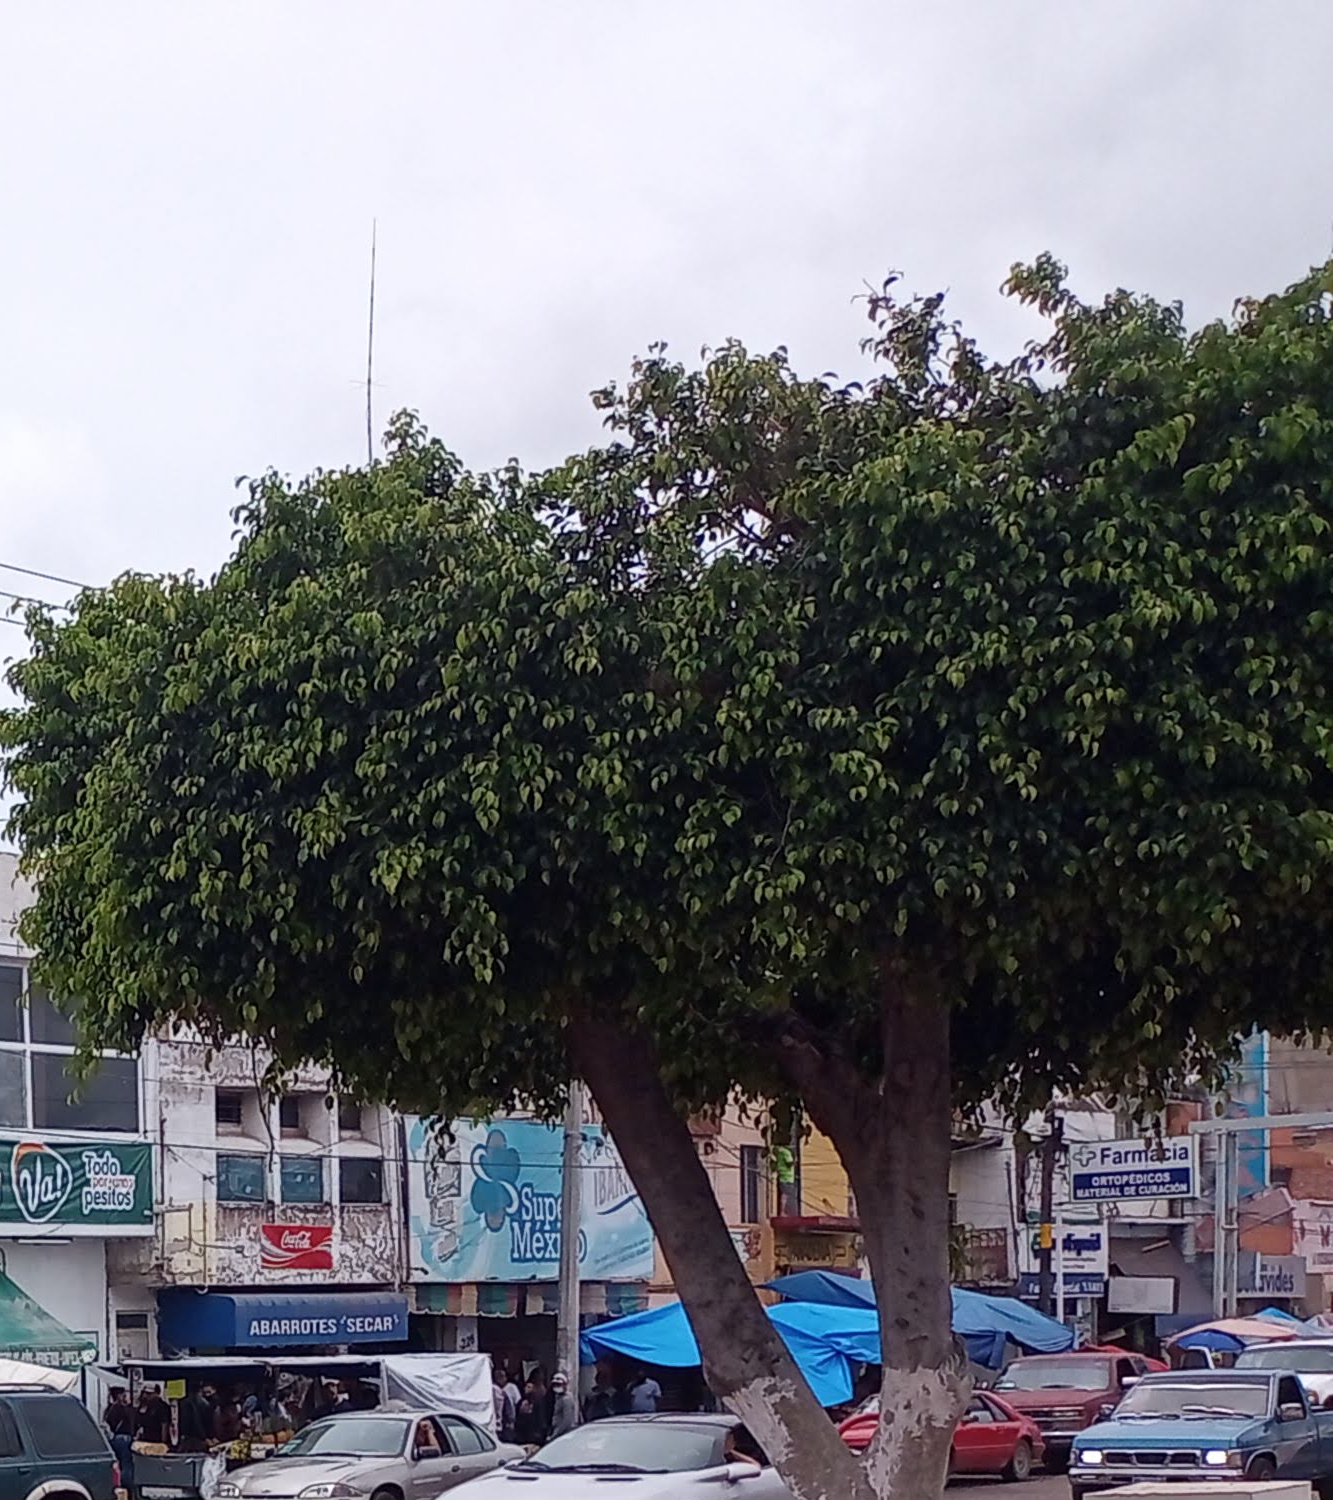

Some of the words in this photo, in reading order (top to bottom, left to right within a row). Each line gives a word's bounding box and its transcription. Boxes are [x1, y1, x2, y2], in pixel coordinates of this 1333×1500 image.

[85, 1152, 119, 1176] Todo
[1099, 1143, 1189, 1166] Farmacia
[19, 1155, 63, 1212] Va!
[1076, 1187, 1121, 1198] MATERIAL
[1124, 1187, 1137, 1196] DE
[84, 1187, 132, 1211] pesitos
[250, 1319, 337, 1336] ABARROTES
